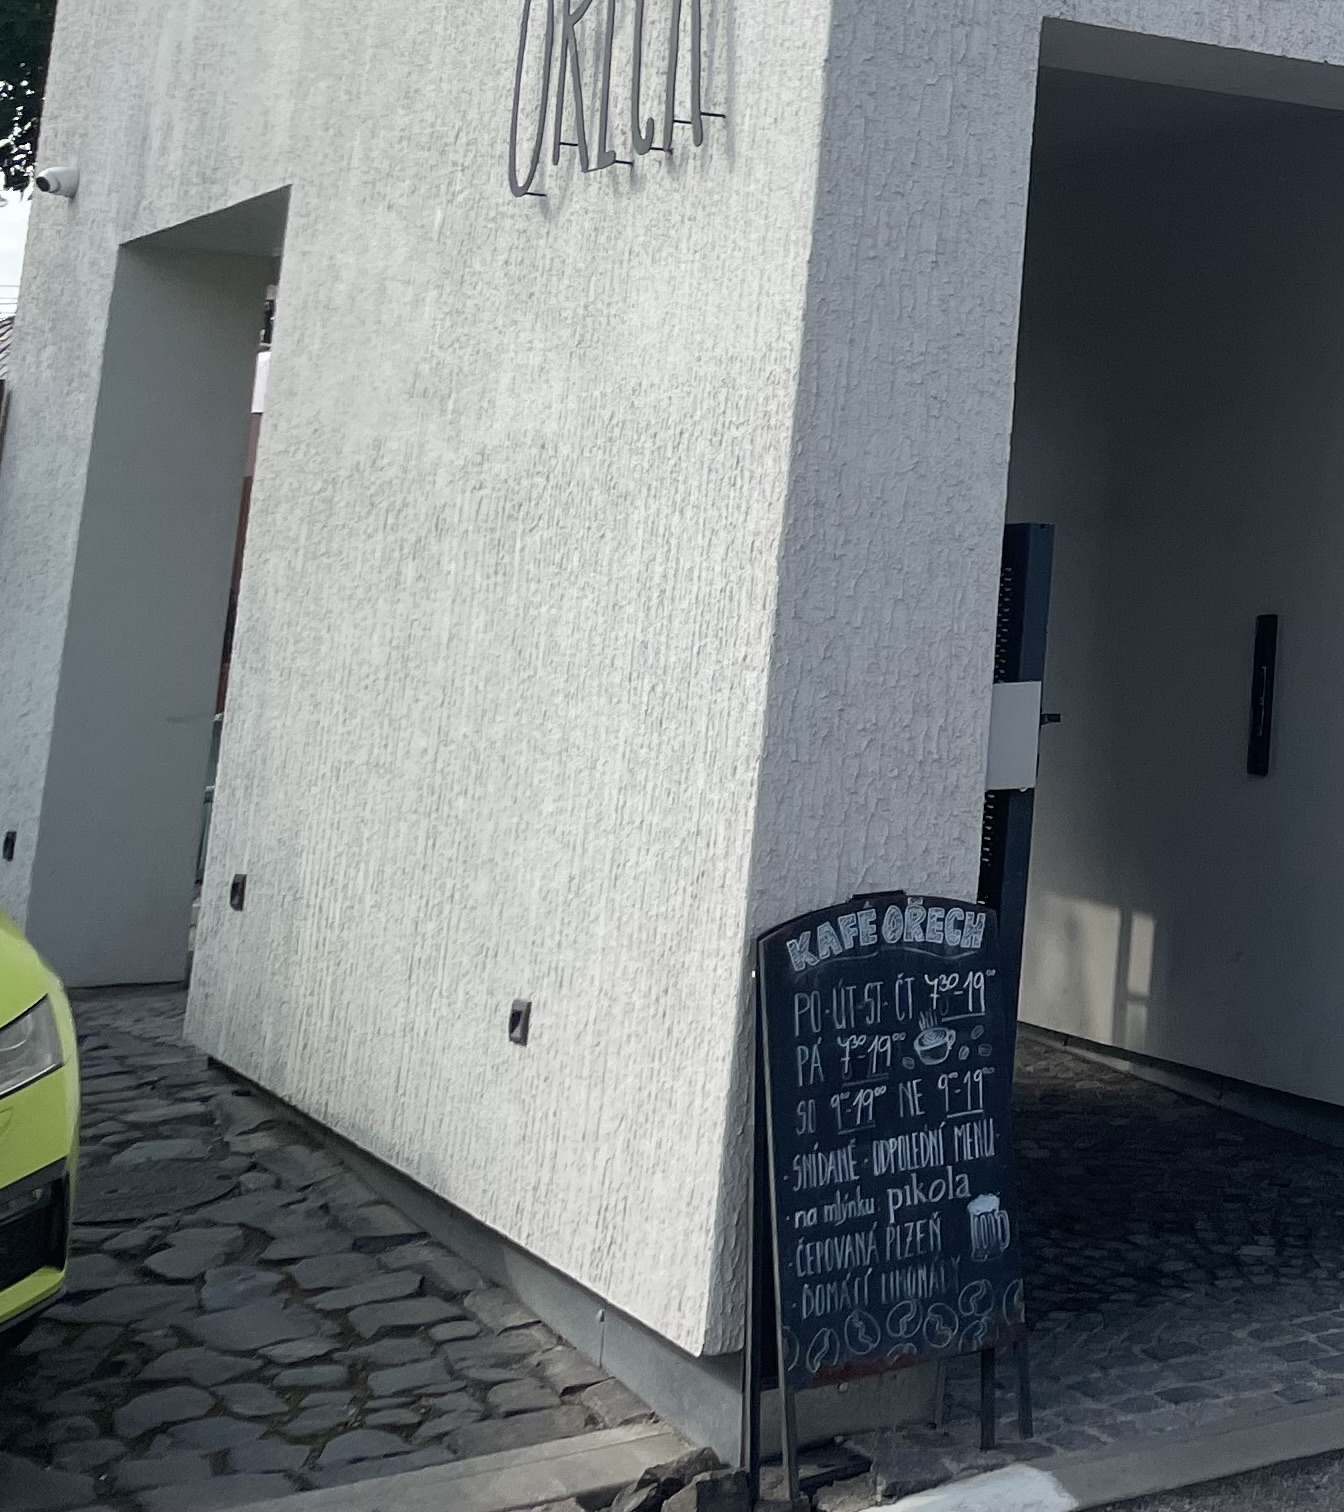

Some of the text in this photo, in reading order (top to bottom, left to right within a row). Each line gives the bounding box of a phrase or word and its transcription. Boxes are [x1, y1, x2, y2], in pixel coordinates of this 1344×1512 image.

[882, 896, 987, 949] OŘECH
[796, 1036, 826, 1087] PÁ
[795, 1098, 817, 1136] SO
[898, 1078, 926, 1118] NE
[794, 1204, 818, 1230] na
[886, 1165, 972, 1224] pikola
